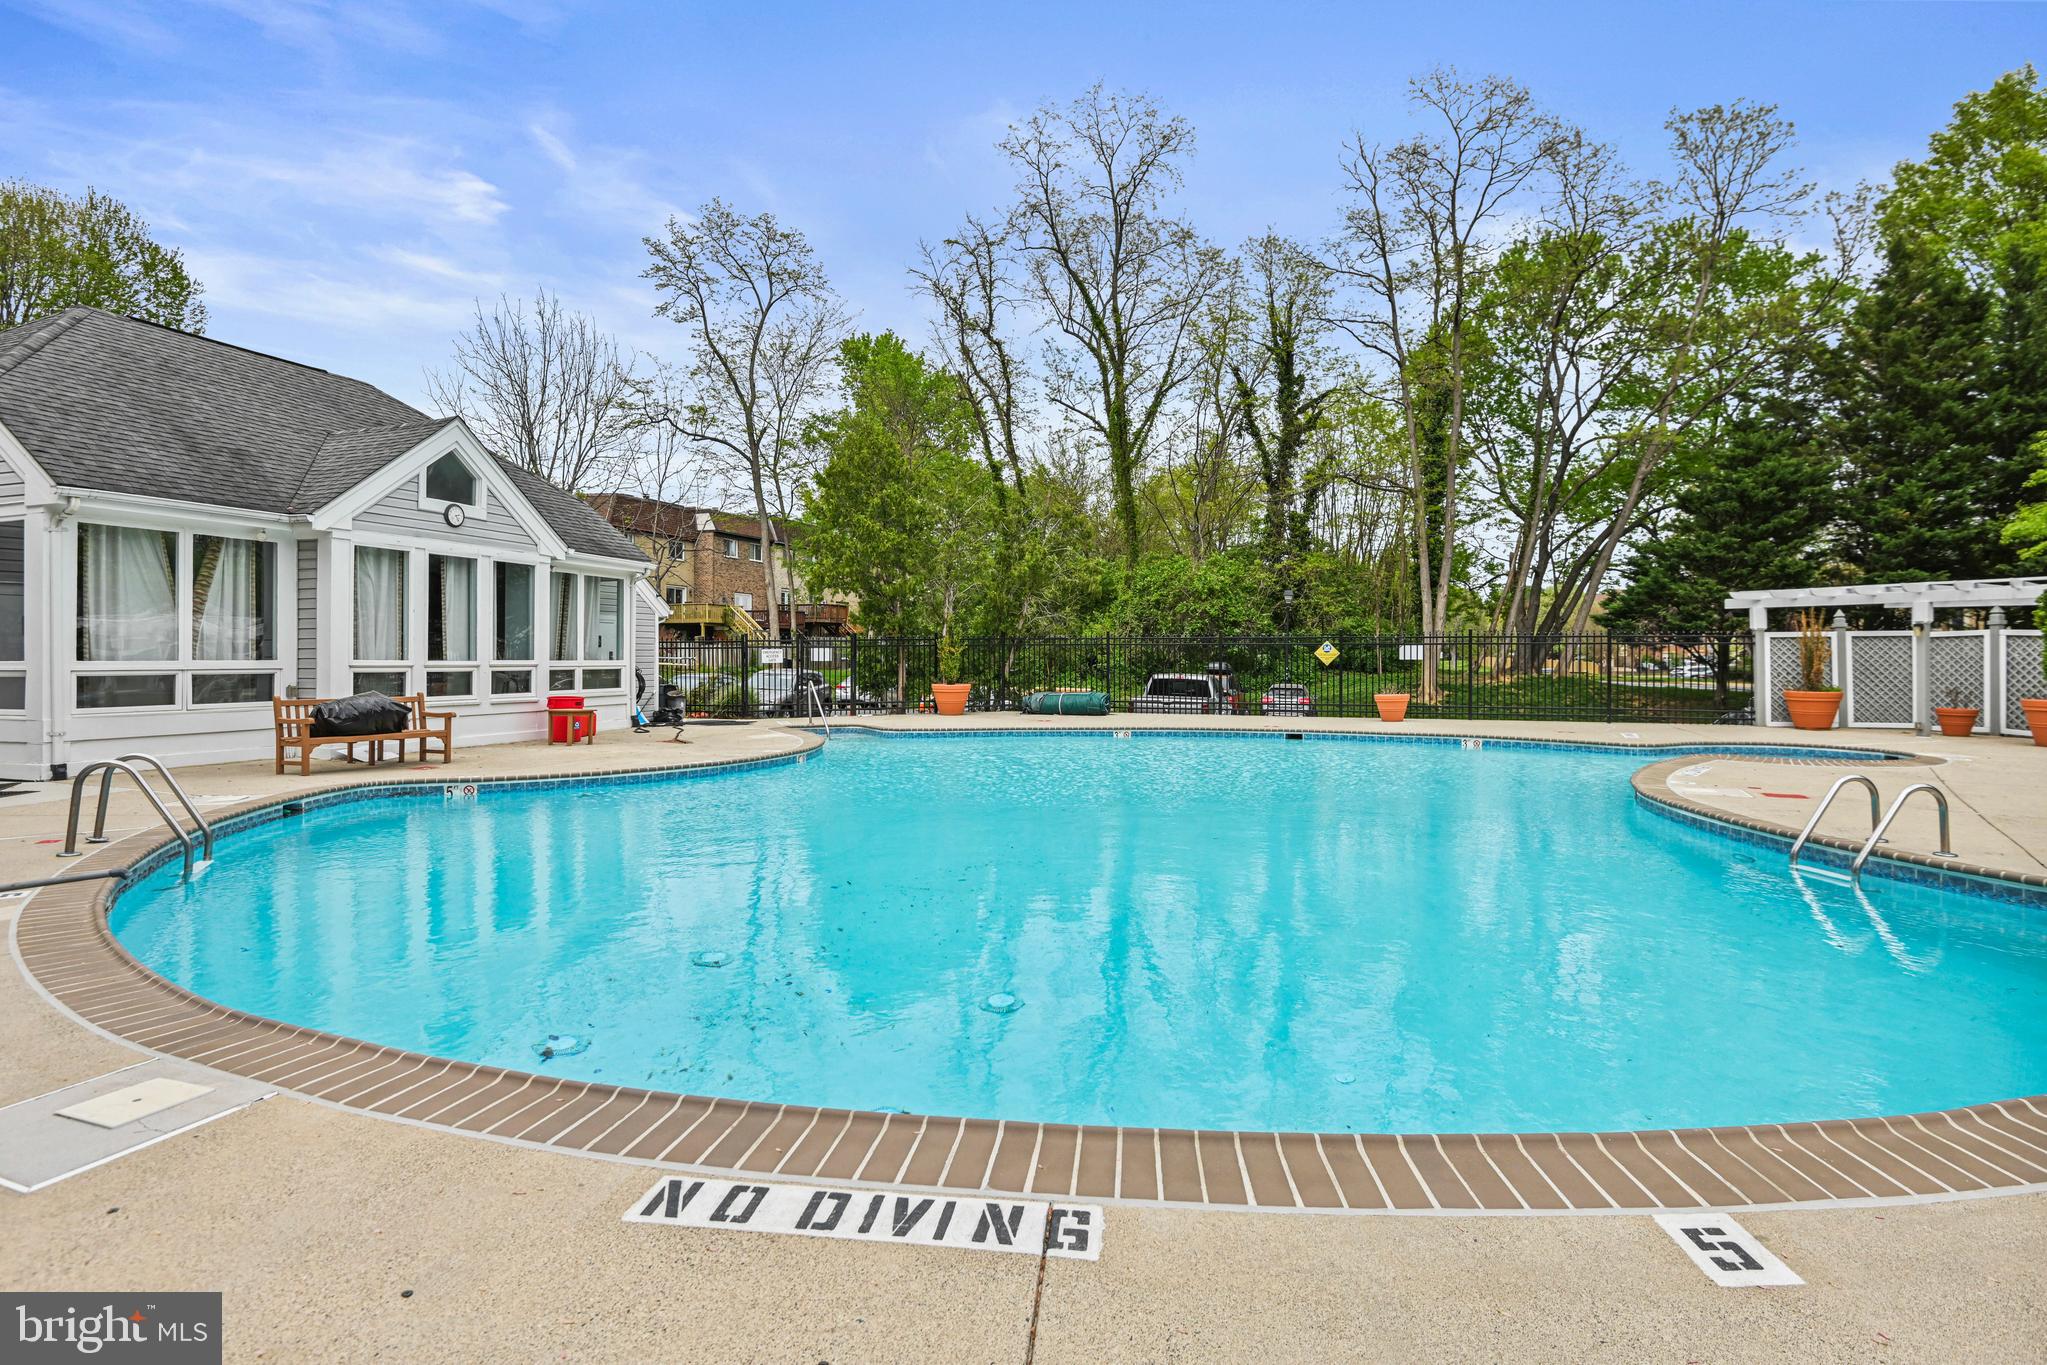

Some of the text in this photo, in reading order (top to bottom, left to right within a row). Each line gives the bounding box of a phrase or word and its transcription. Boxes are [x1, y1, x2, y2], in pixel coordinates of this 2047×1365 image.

[446, 785, 453, 800] 5
[640, 1179, 1092, 1252] NO DIVING
[1680, 1227, 1765, 1271] 5
